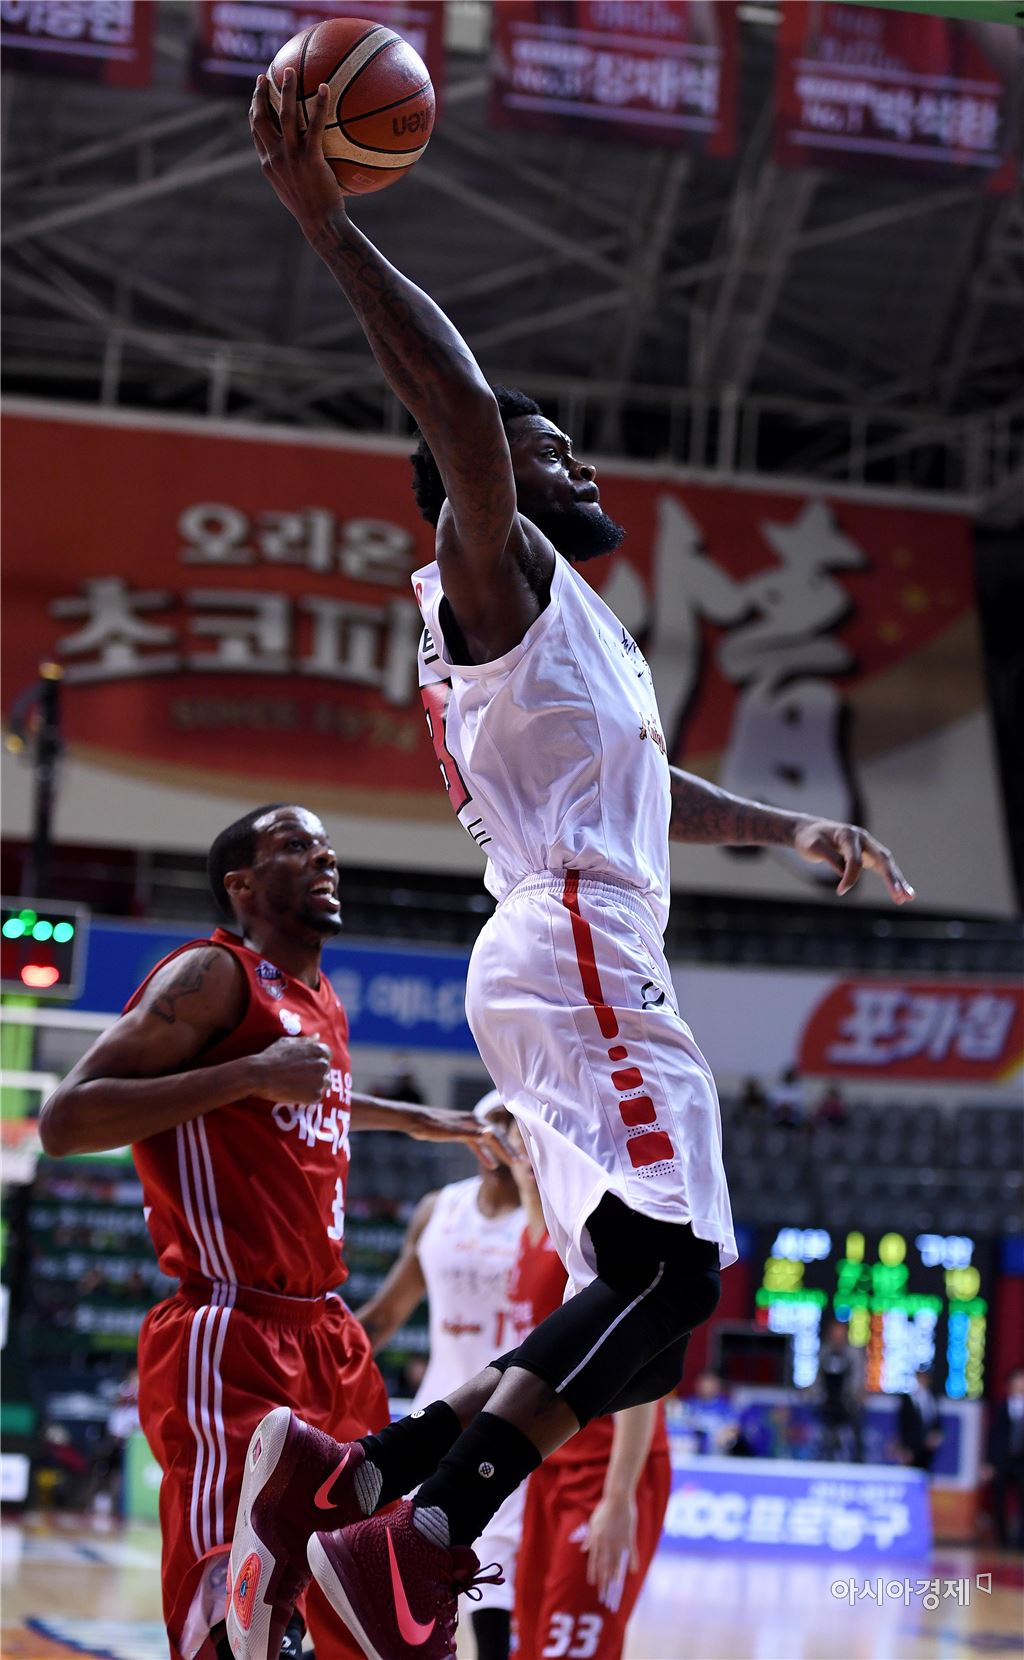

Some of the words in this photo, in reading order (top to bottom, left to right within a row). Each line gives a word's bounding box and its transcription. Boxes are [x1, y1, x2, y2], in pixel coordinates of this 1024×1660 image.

[178, 501, 413, 582] 오리온
[827, 986, 1014, 1066] 포카칩
[541, 1611, 604, 1659] 33
